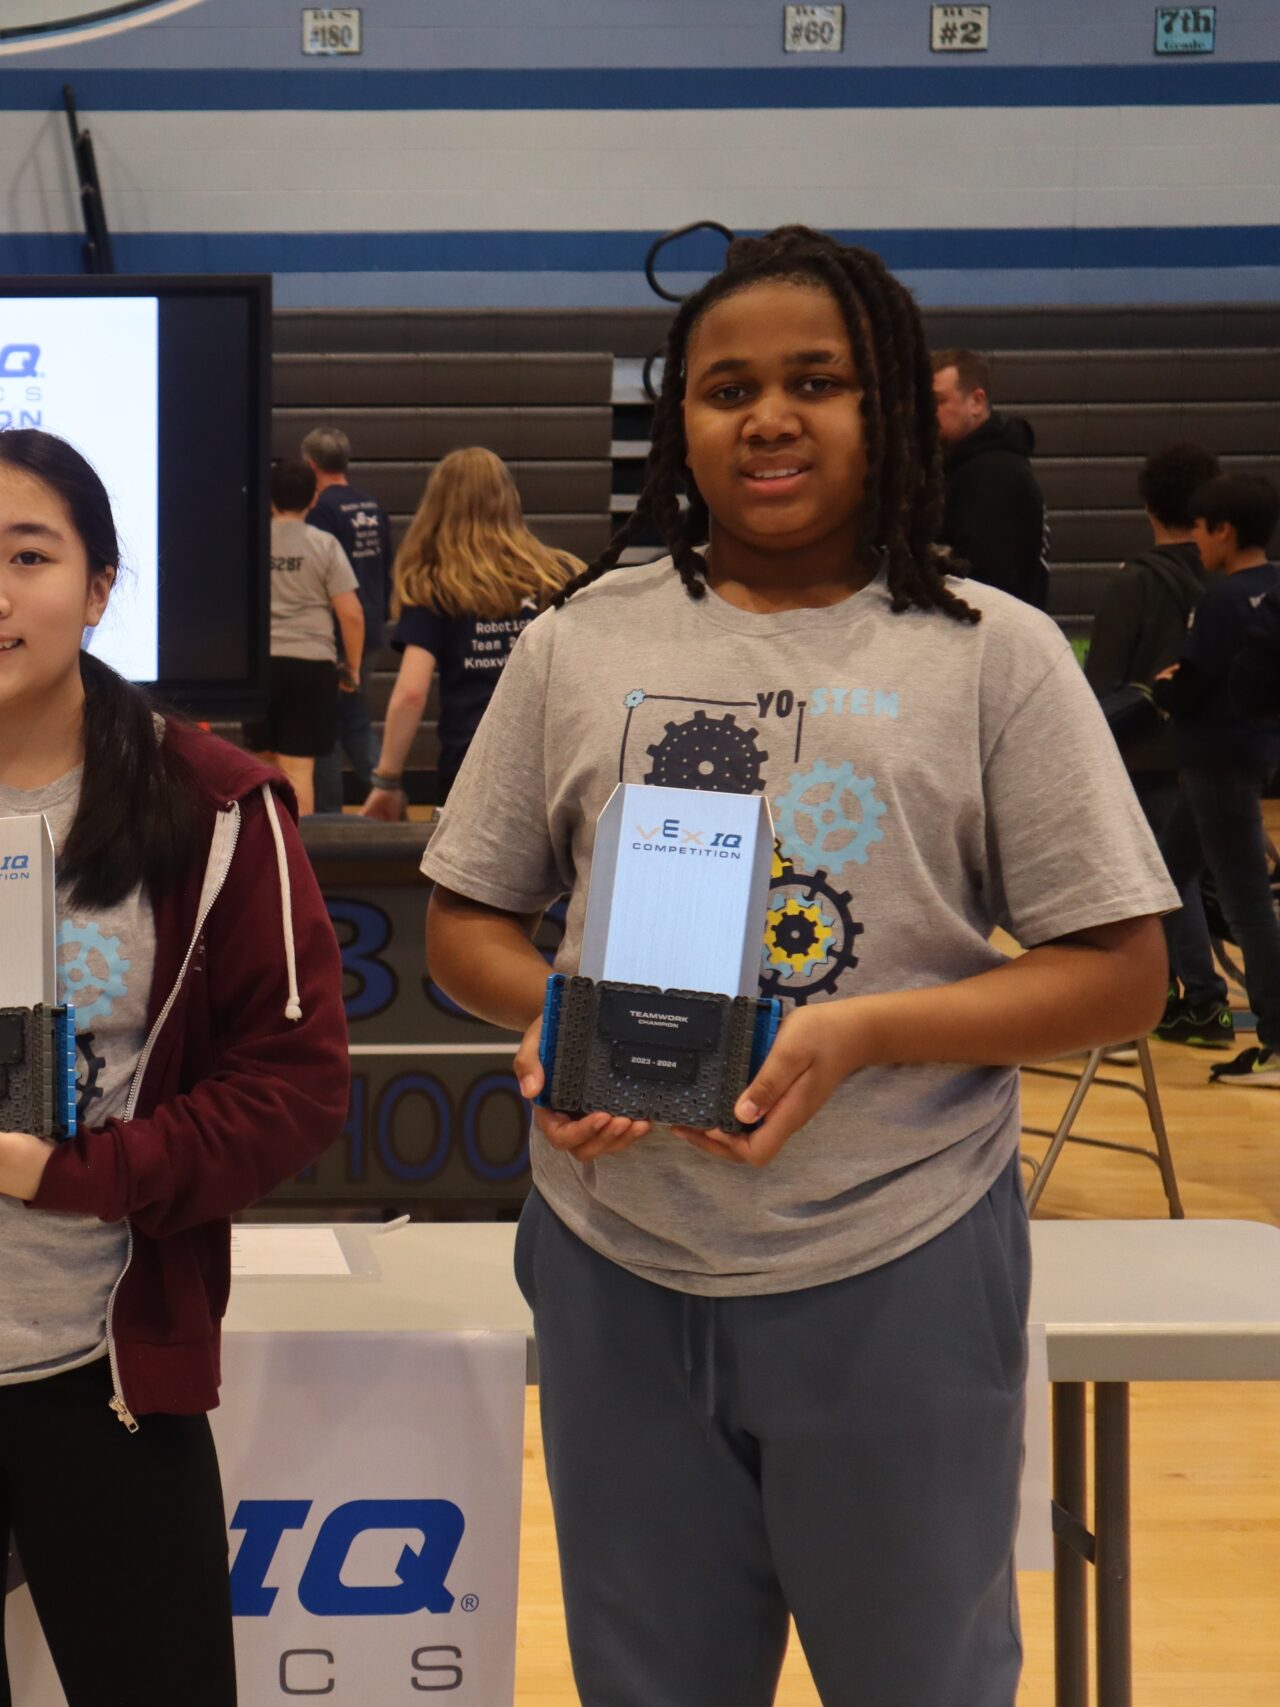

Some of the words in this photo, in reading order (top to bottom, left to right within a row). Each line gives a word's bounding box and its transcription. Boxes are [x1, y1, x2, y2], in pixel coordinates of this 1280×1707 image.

[1160, 9, 1211, 33] 7th
[792, 21, 834, 44] #60
[940, 22, 982, 44] #2
[472, 640, 502, 651] Team
[710, 833, 742, 848] IQ
[632, 842, 741, 860] COMPETITION
[1, 855, 29, 870] IQ
[629, 1010, 688, 1023] TEAMWORK
[637, 1019, 679, 1029] CHAMPION
[631, 1057, 651, 1065] 2023
[657, 1059, 677, 1068] 2024
